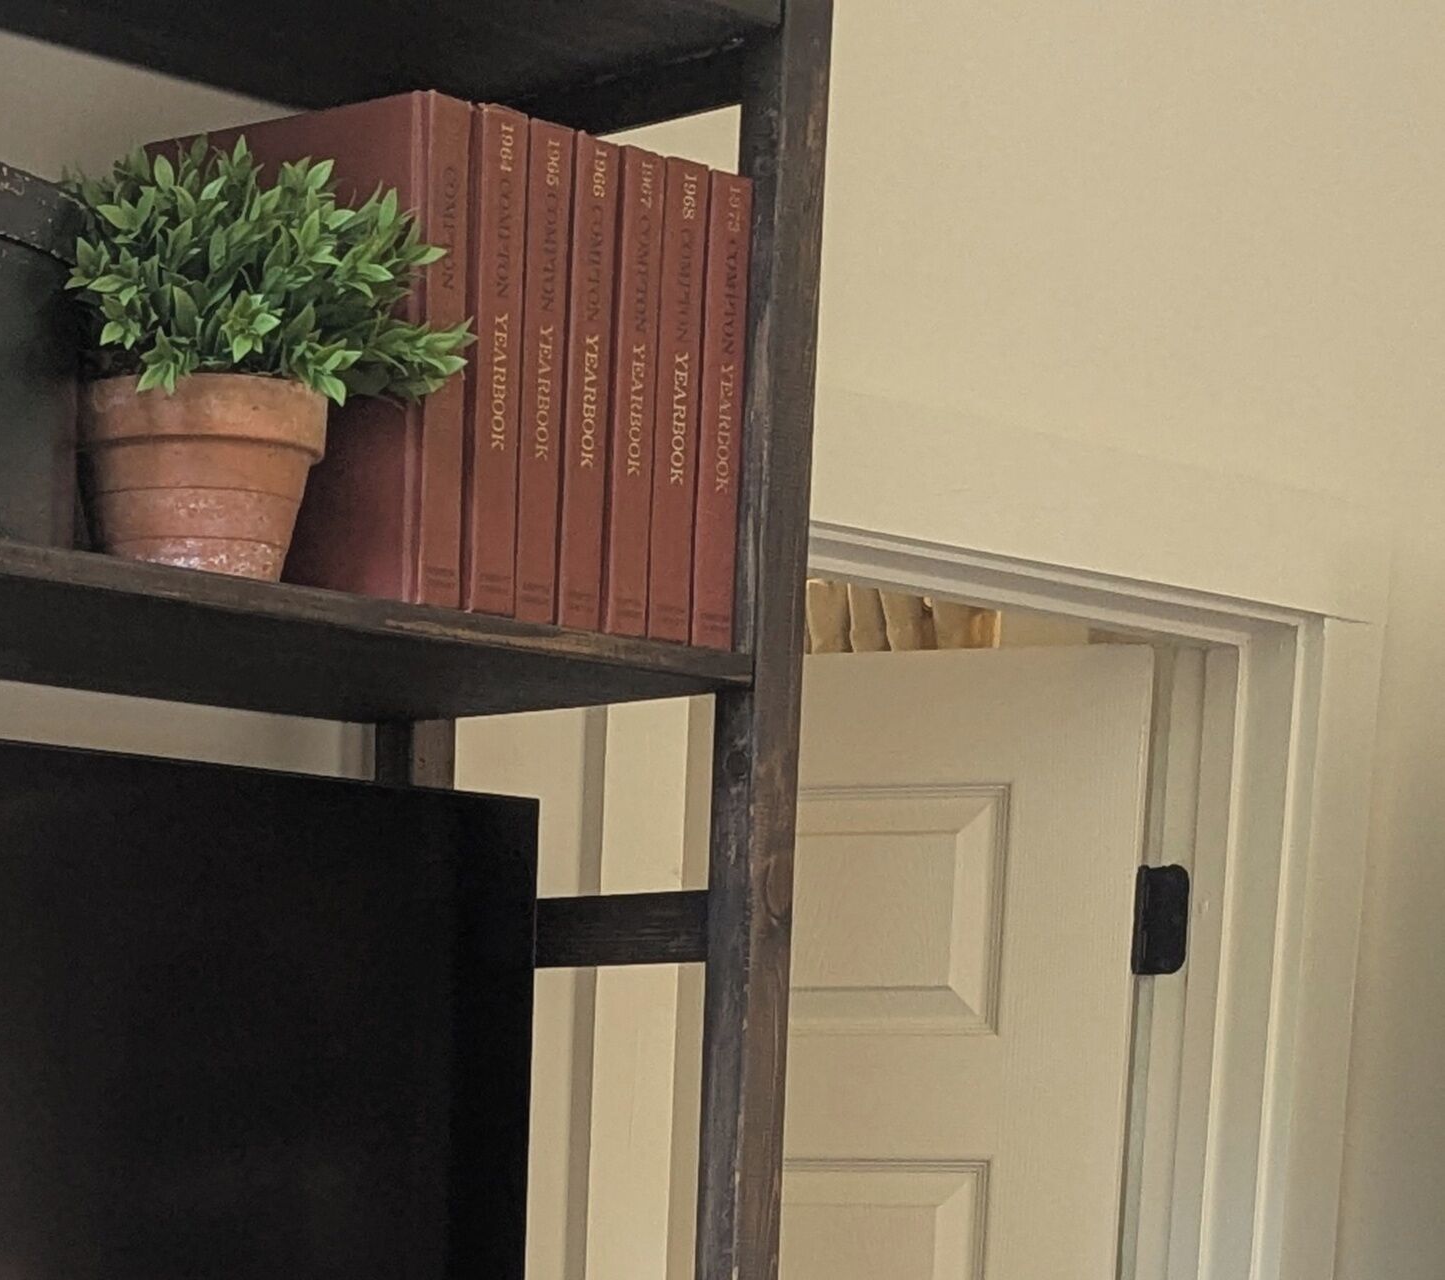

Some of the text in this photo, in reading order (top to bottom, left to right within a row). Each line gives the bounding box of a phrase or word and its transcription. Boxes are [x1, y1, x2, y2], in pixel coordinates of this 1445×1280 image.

[495, 178, 512, 299] COMPTON
[592, 148, 607, 198] 1966
[640, 160, 654, 210] 1967
[681, 172, 699, 222] 1968
[535, 139, 561, 462] 1965 COMPTON YEARBOOK
[490, 312, 509, 451] YEARBOOK
[580, 333, 600, 469] YEARBOOK
[626, 343, 646, 478] YEARBOOK
[669, 351, 690, 487] YEARBOOK
[715, 363, 735, 494] YEARBOOK
